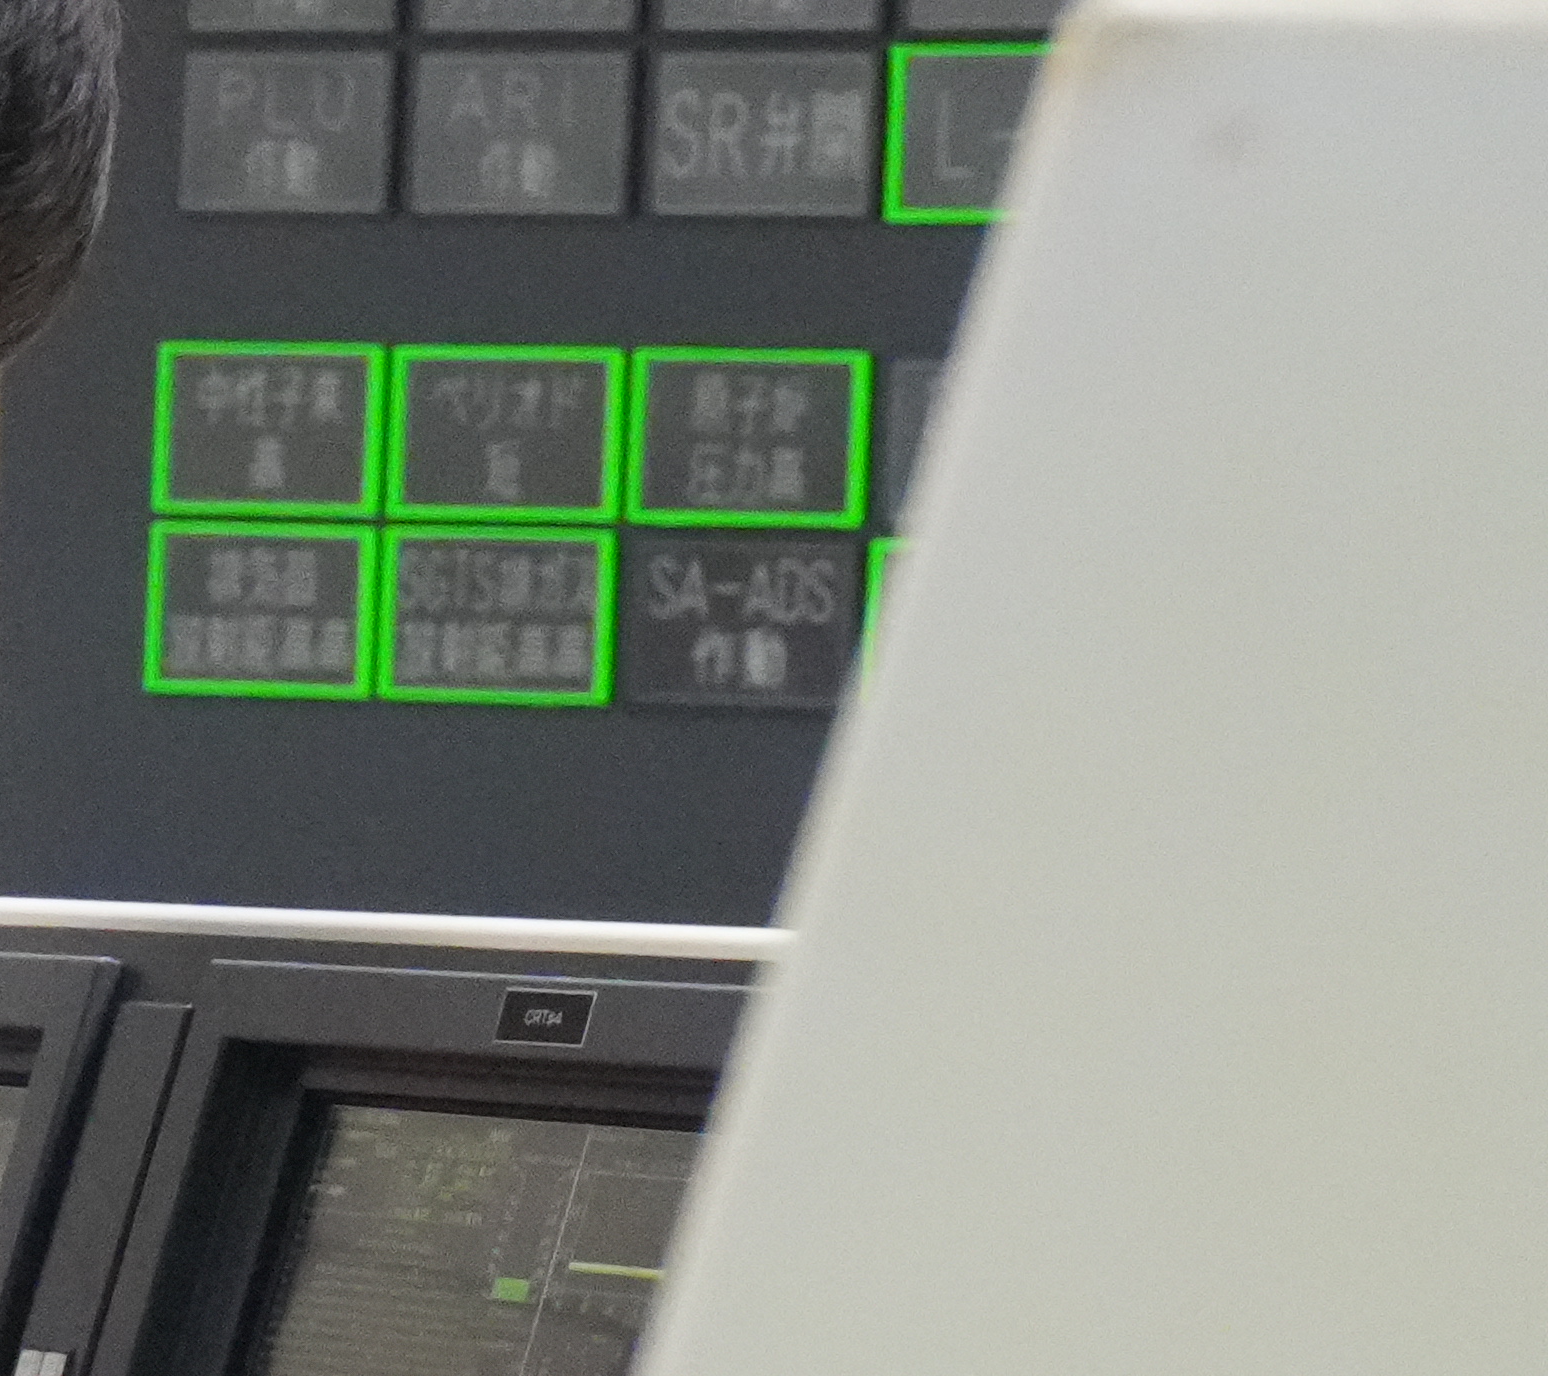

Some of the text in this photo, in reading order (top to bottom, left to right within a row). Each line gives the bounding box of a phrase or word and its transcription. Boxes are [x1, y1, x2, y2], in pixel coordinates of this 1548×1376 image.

[216, 68, 354, 132] PLU
[449, 71, 574, 130] ARI
[648, 553, 836, 626] SA-ADS
